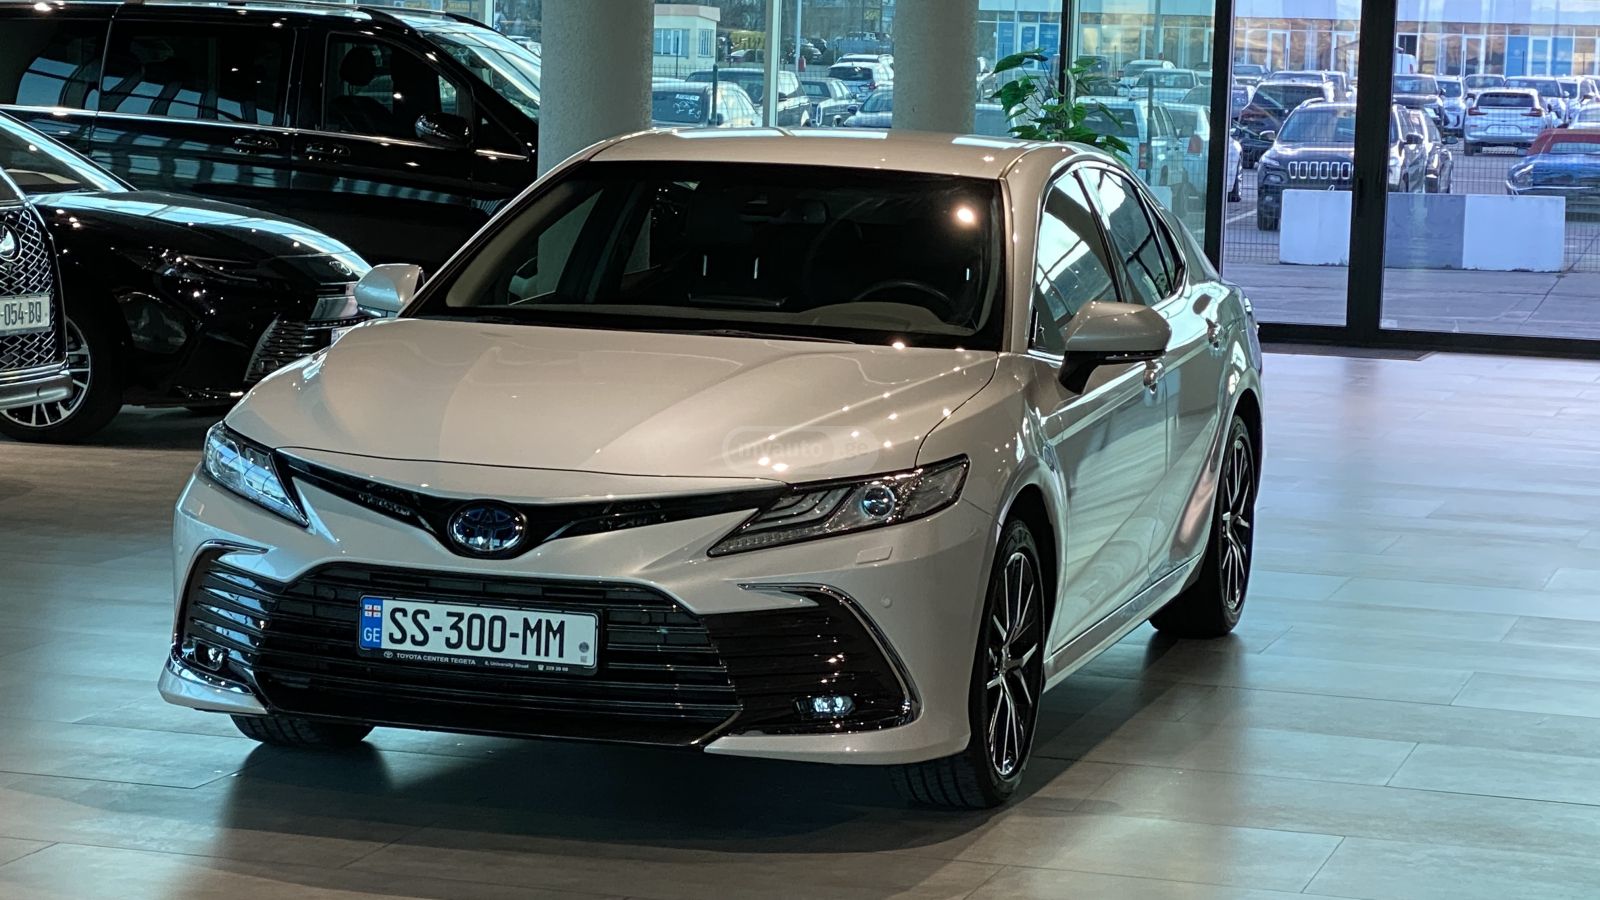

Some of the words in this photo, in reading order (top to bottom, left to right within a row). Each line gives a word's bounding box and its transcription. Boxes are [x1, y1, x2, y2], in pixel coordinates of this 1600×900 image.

[363, 627, 381, 643] GE
[388, 607, 566, 658] SS-300-MM
[396, 652, 422, 661] TOYOTA
[423, 655, 449, 663] CENTER
[450, 657, 476, 665] TEGETA
